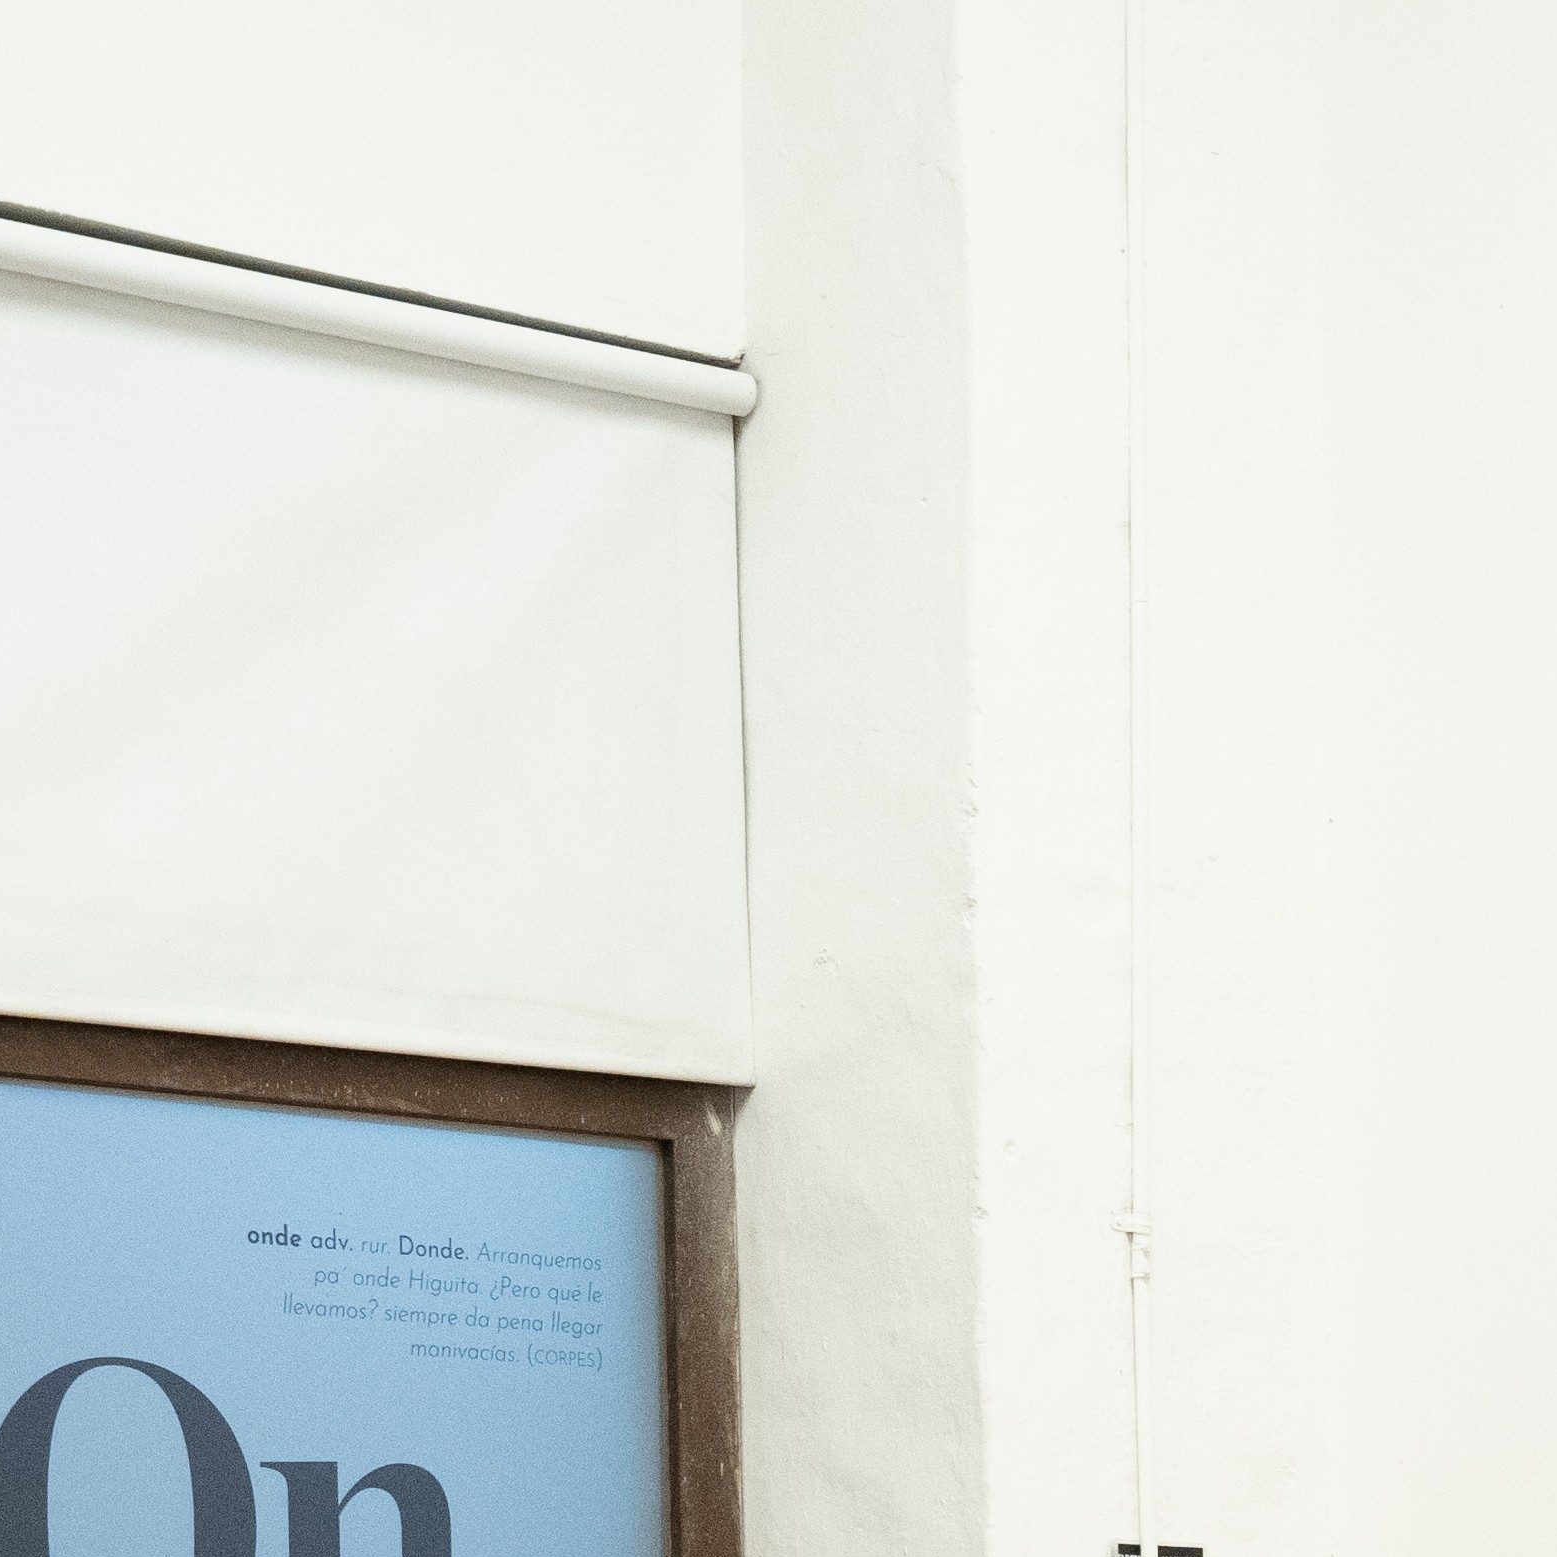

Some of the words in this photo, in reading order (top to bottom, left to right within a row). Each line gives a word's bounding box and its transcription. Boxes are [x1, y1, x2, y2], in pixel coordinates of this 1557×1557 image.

[247, 1224, 301, 1248] onde
[311, 1229, 353, 1251] adv.
[361, 1239, 392, 1255] rur.
[399, 1235, 469, 1261] Donde.
[477, 1242, 602, 1271] Arranquemos
[353, 1267, 401, 1288] onde
[409, 1269, 482, 1296] Higuita.
[490, 1276, 541, 1301] ¿Pero
[548, 1284, 581, 1302] qué
[589, 1282, 602, 1303] le
[282, 1292, 378, 1320] llevamos?
[384, 1308, 457, 1328] siempre
[465, 1307, 489, 1328] da
[497, 1315, 543, 1332] pena
[551, 1312, 603, 1338] llegar
[411, 1341, 519, 1362] manivacías.
[527, 1344, 602, 1371] (CORPES)
